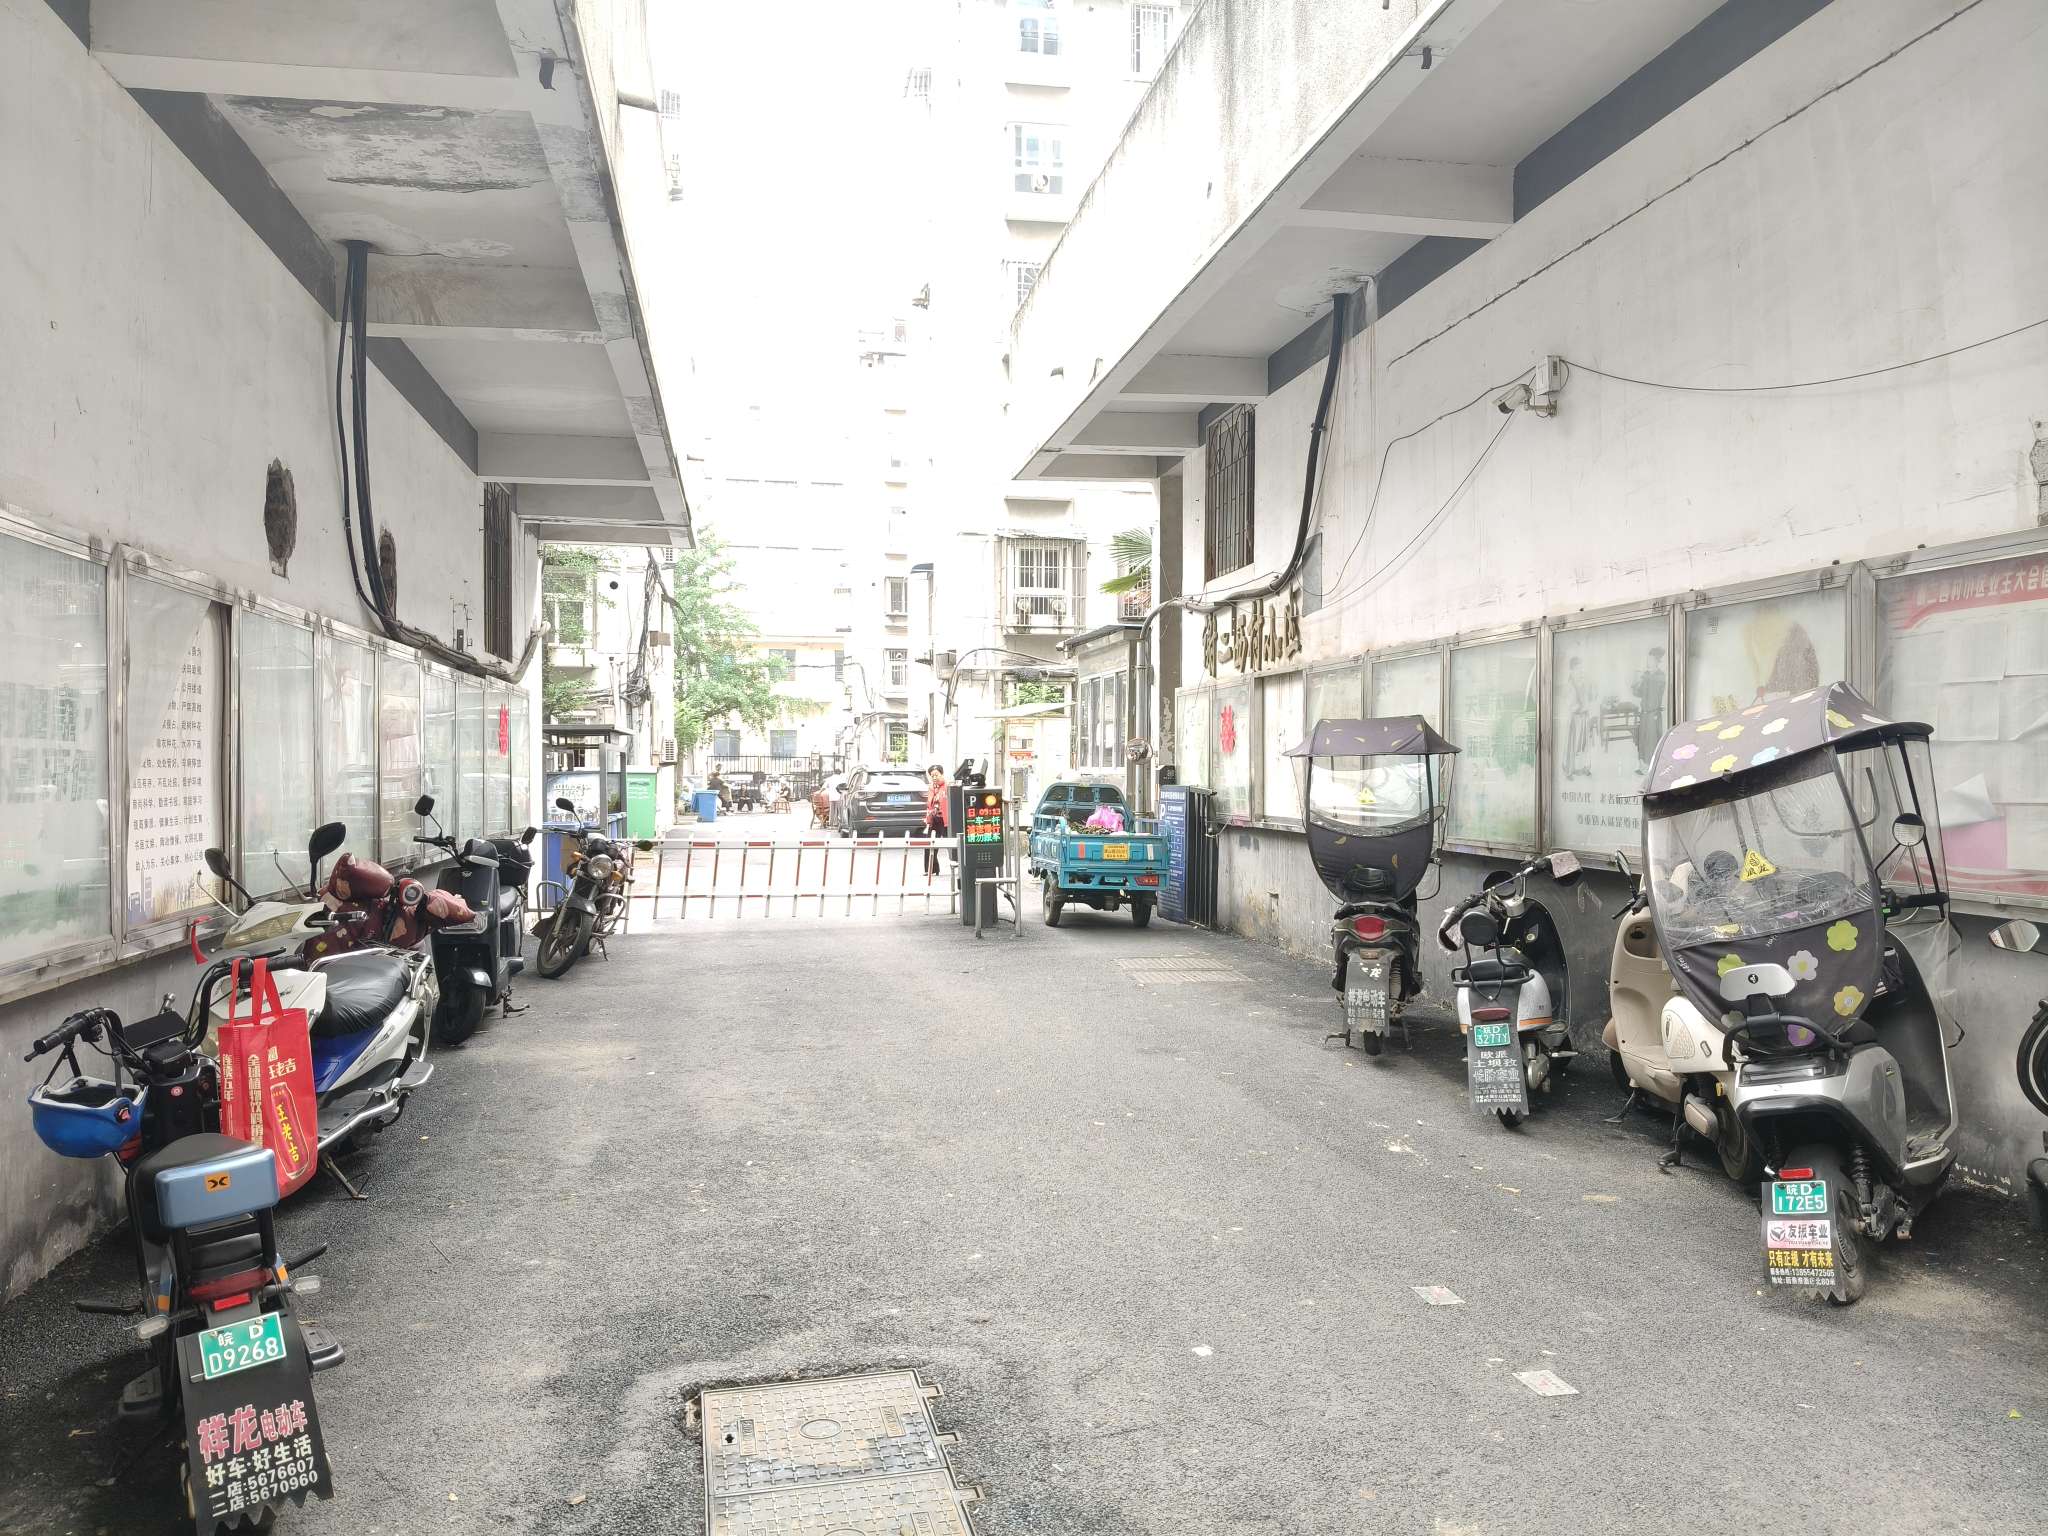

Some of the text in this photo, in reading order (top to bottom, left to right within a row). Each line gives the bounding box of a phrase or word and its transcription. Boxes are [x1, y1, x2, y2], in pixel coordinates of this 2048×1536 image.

[970, 795, 977, 806] P
[276, 1102, 300, 1163] 王老吉
[1785, 1183, 1813, 1196] 皖D
[1777, 1194, 1825, 1211] 172E5
[1801, 1250, 1834, 1268] 才有未来
[218, 1325, 265, 1346] 皖 D
[208, 1337, 280, 1374] D9268
